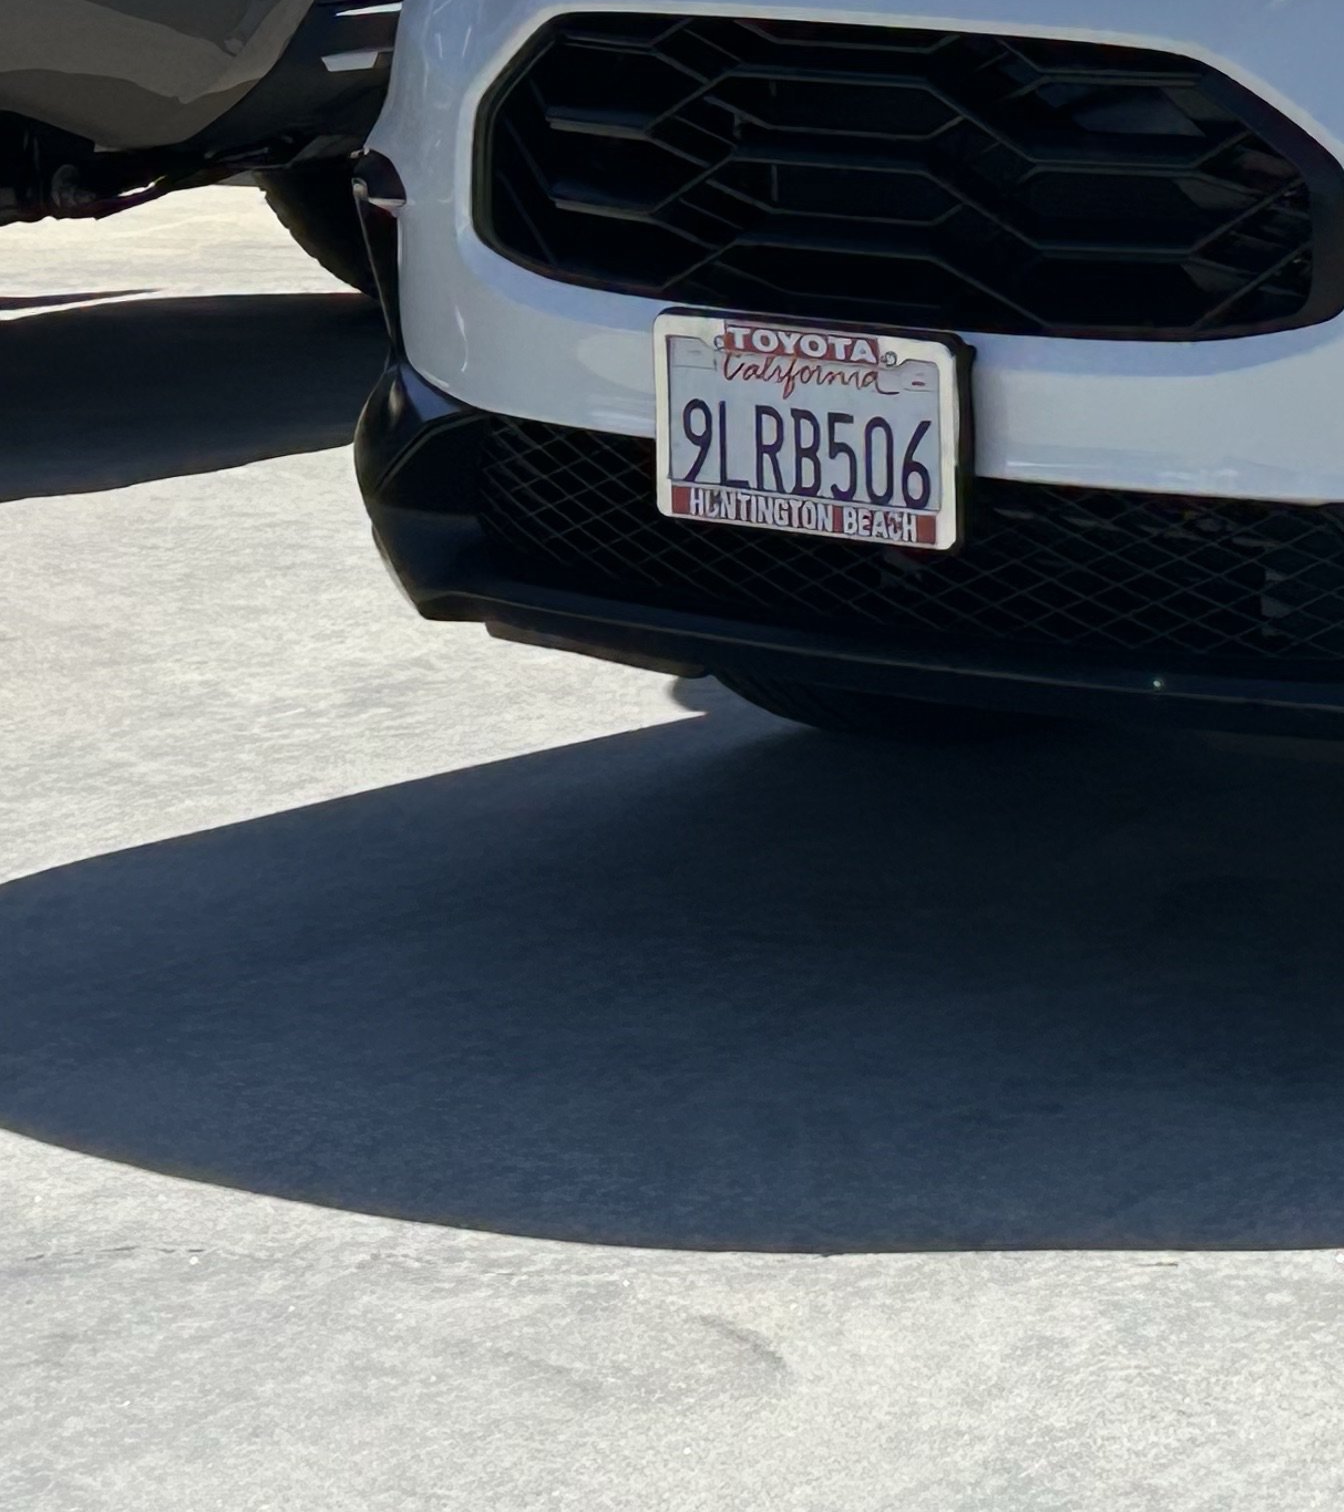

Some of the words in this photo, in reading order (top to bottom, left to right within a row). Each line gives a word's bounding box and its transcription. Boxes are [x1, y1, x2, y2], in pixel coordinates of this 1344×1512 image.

[727, 326, 878, 364] TOYOTA
[722, 354, 900, 400] California
[682, 397, 932, 510] 9LRB506
[842, 506, 918, 543] BEACH
